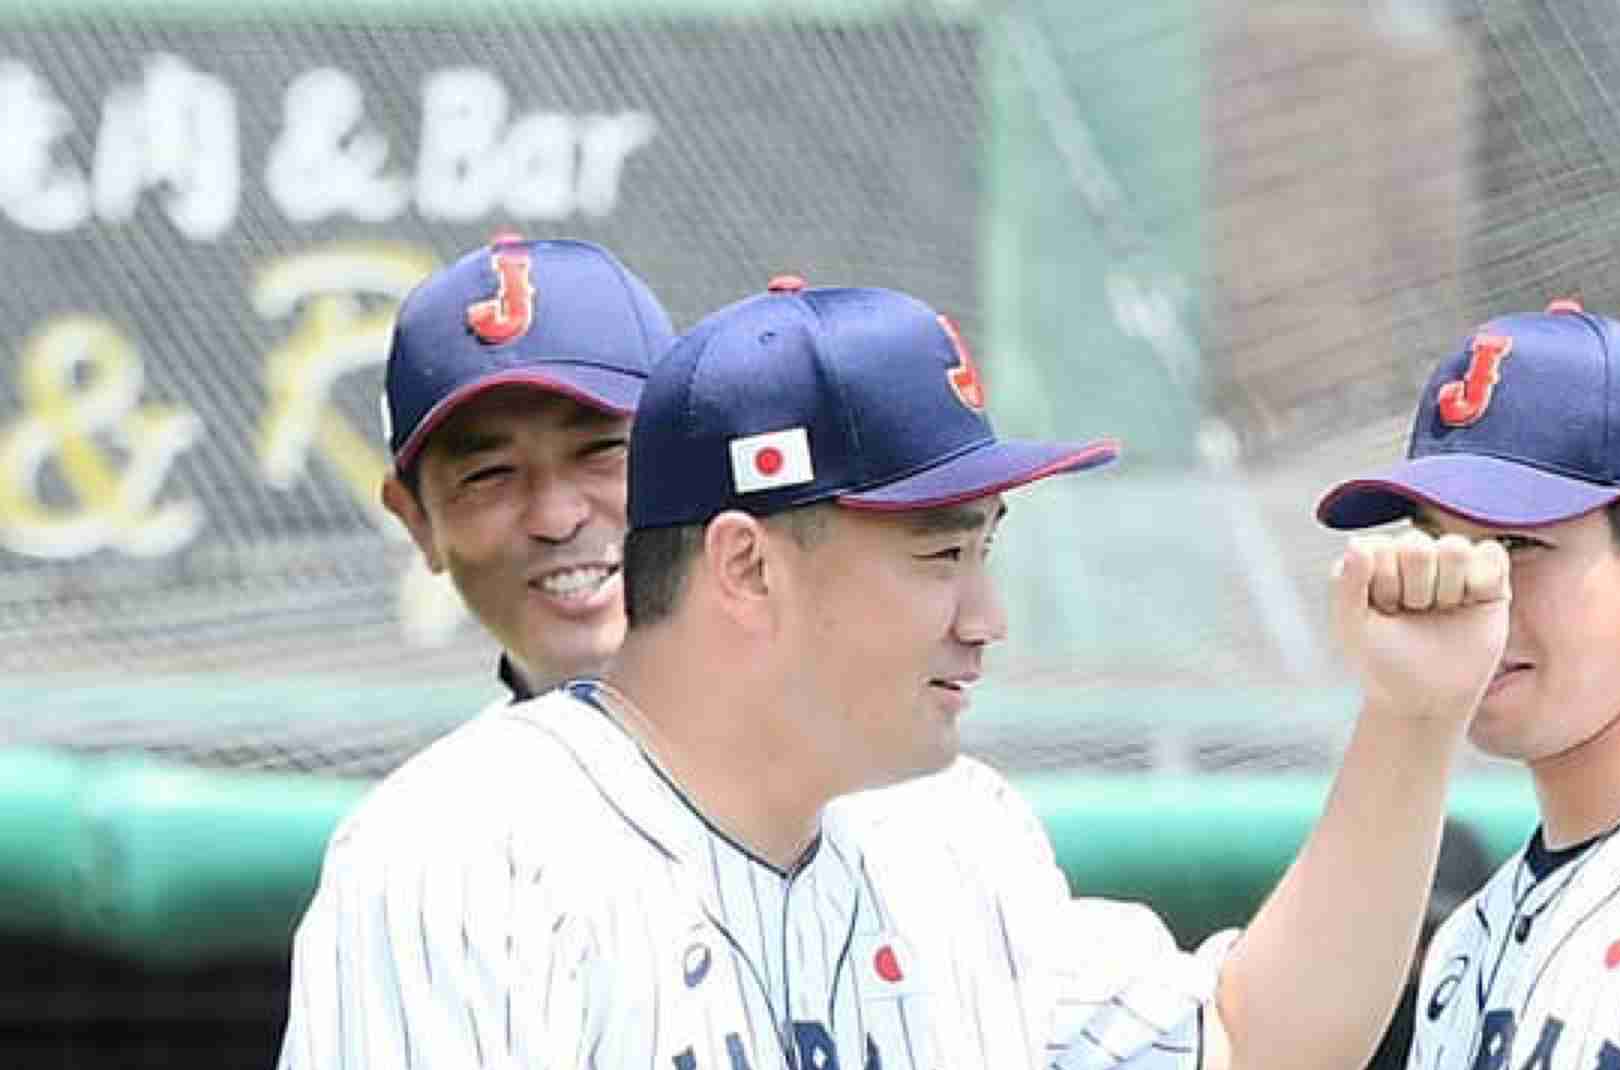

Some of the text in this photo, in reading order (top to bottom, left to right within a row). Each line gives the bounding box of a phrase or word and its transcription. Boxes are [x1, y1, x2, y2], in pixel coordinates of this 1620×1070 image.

[415, 68, 656, 222] Bar
[467, 254, 535, 345] J
[1437, 335, 1513, 428] J
